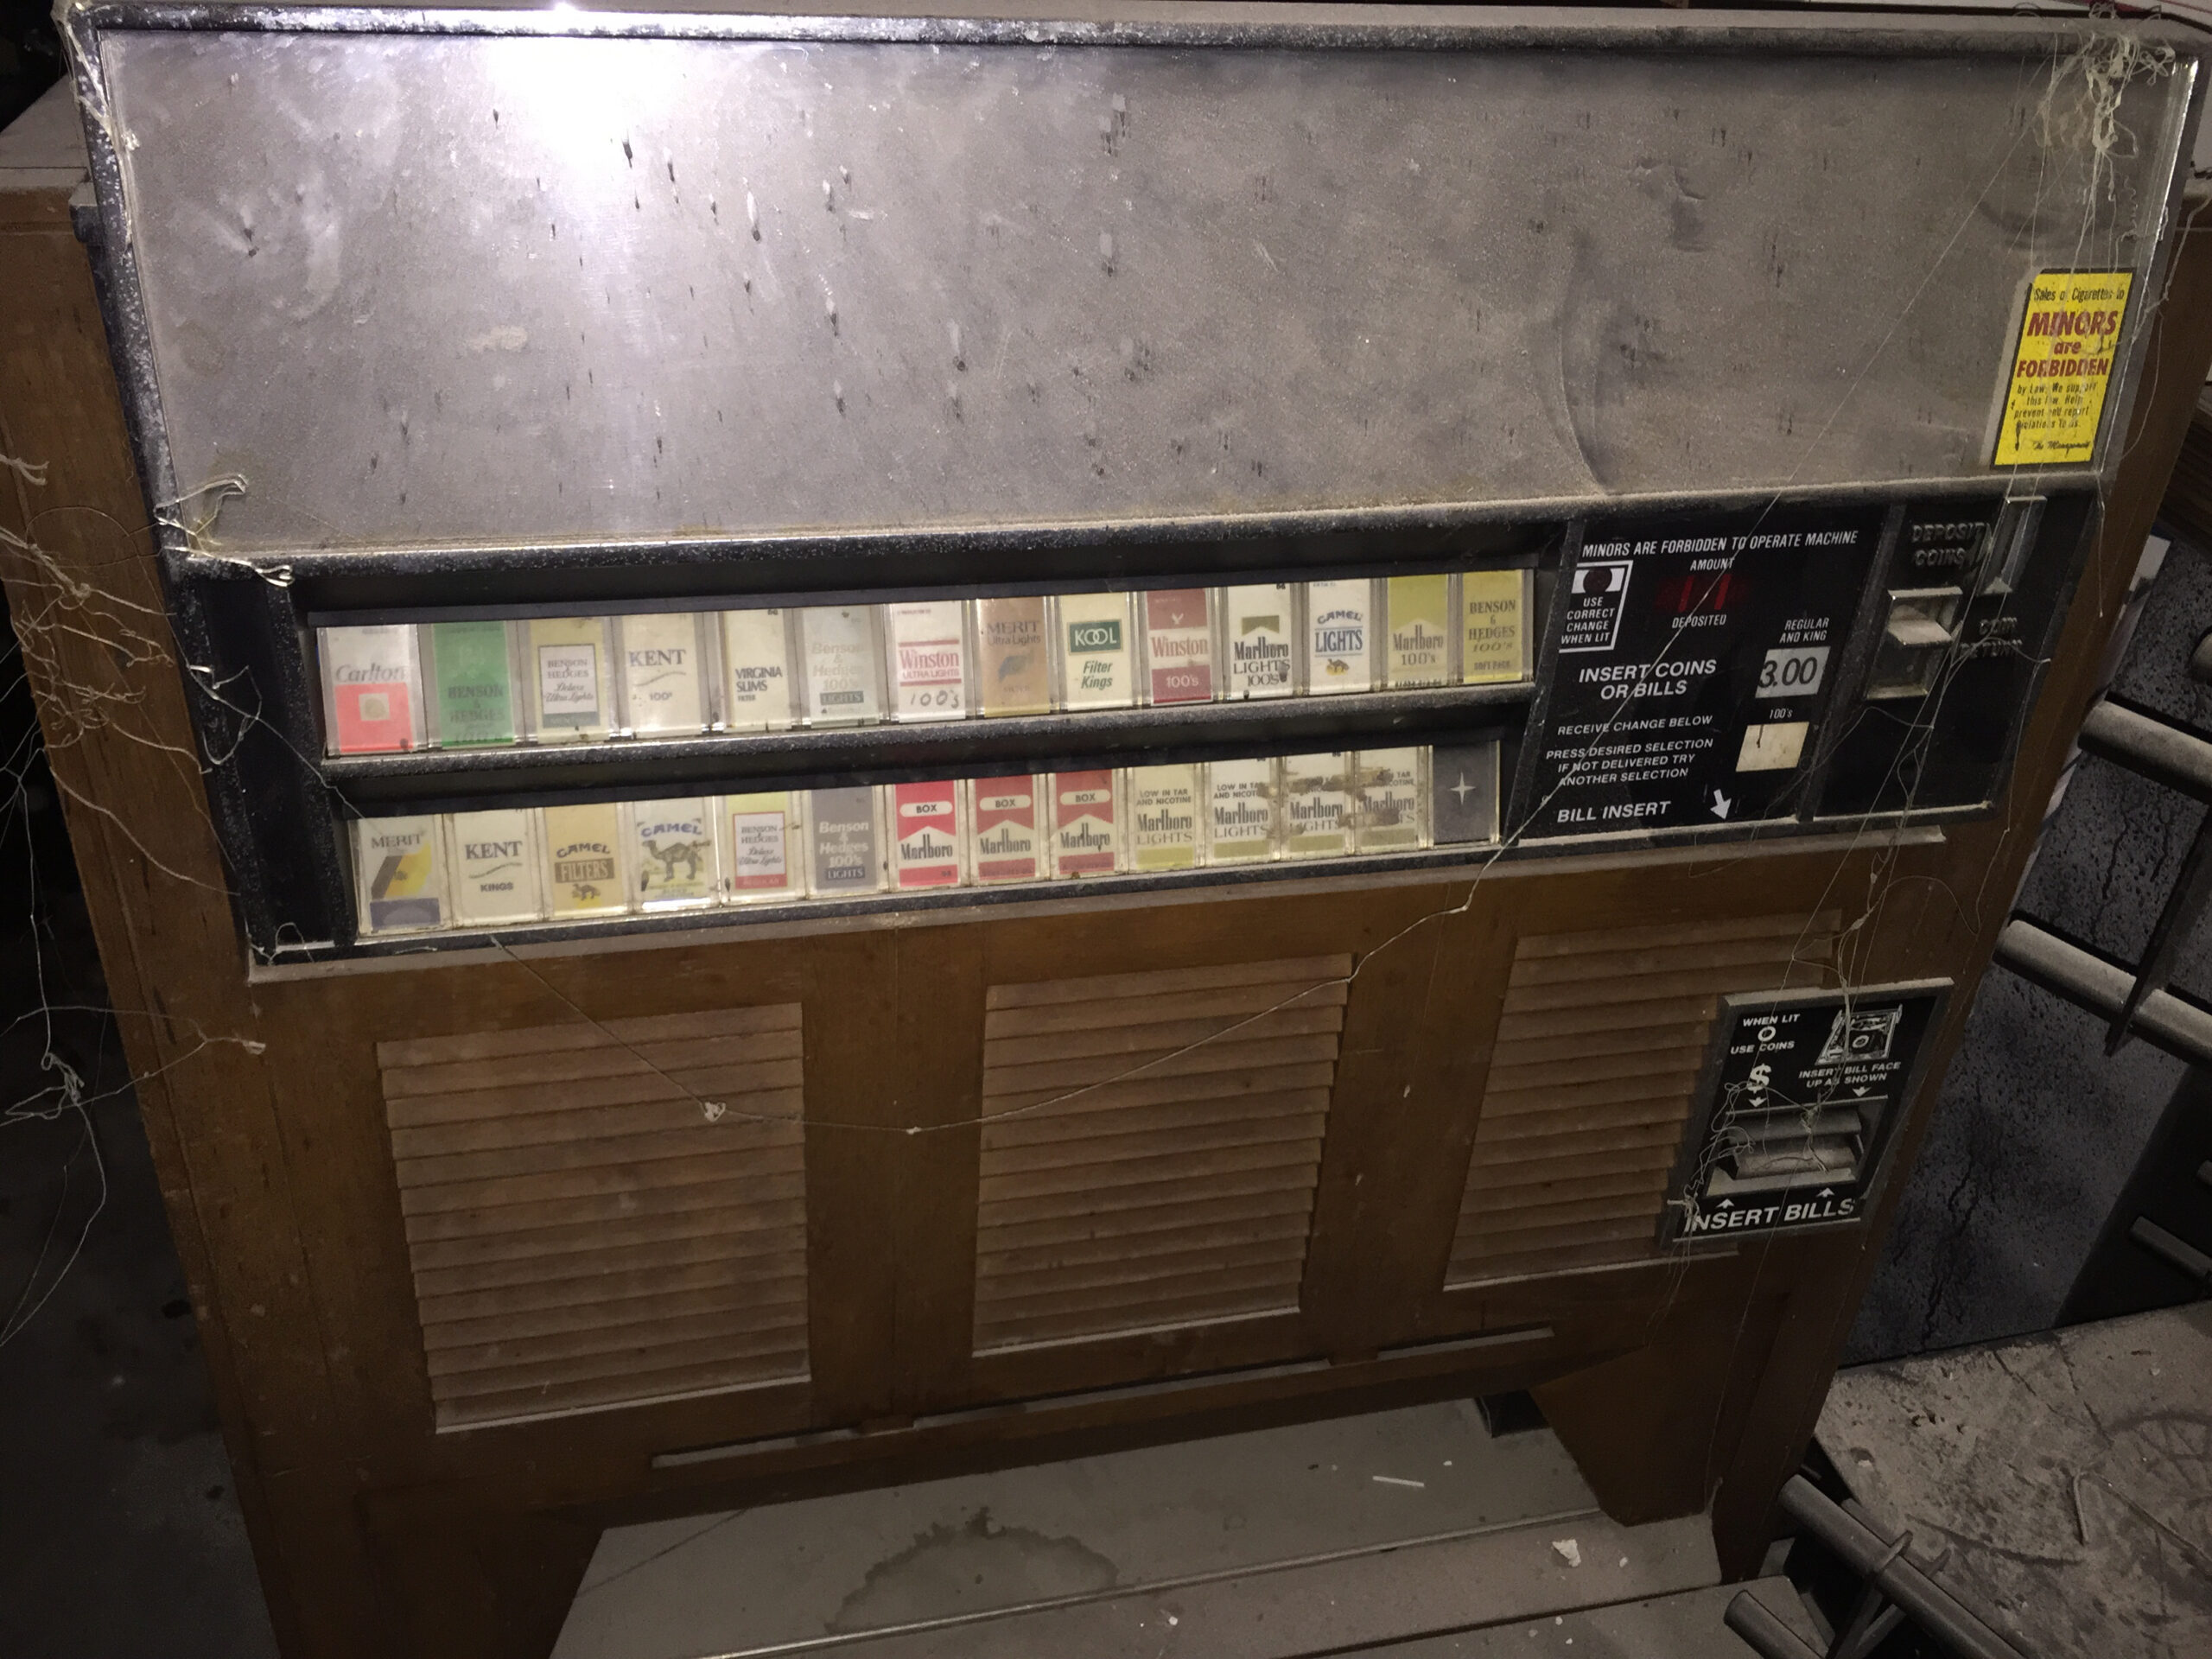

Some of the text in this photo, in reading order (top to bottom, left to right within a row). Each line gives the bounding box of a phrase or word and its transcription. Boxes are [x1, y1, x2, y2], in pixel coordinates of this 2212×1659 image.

[2034, 288, 2056, 302] Sales
[2027, 311, 2118, 336] MINORS
[2054, 341, 2082, 354] are
[2017, 359, 2109, 378] FORBIDDEN
[2018, 384, 2027, 395] by
[2066, 382, 2097, 392] suport
[2027, 396, 2041, 406] this
[2045, 396, 2058, 405] lw
[2014, 408, 2044, 420] prevent
[2049, 406, 2062, 416] nd
[2017, 420, 2056, 429] iolatios
[1582, 531, 1859, 558] MINORS ARE FORBIDDEN TO OPERATE MACHINE
[1690, 557, 1734, 571] AMOUNT
[1470, 599, 1516, 614] BENSON
[1583, 596, 1603, 607] USE
[1317, 609, 1363, 625] CAMEL
[1567, 608, 1615, 620] CORRECT
[987, 620, 1039, 634] MERIT
[1567, 620, 1609, 632] CHANGE
[1672, 614, 1727, 629] DEPOSITED
[1785, 618, 1829, 631] REGULAR
[988, 632, 1041, 646] Ultra Lights
[1075, 627, 1117, 646] KOOL
[1315, 629, 1363, 652] LIGHTS
[1393, 625, 1444, 652] Marlboro
[1469, 626, 1516, 642] HEDGES
[1560, 632, 1610, 645] WHEN LIT
[1780, 630, 1827, 644] AND KING
[1151, 636, 1208, 658] Winston
[1234, 636, 1289, 661] Marlboro
[547, 659, 588, 669] BENSON
[629, 649, 686, 667] KENT
[899, 648, 959, 670] Winston
[1402, 652, 1437, 666] 100's
[335, 662, 406, 683] Carlton
[735, 666, 783, 679] VIRGINIA
[902, 669, 960, 679] ULTRA LIGHTS
[1084, 660, 1113, 674] Filter
[1233, 659, 1290, 675] LIGHTS
[1579, 659, 1718, 683] INSERT COINS
[1758, 657, 1818, 689] 3.00
[547, 670, 589, 679] HEDGES
[1166, 675, 1198, 688] 100's
[448, 683, 503, 698] BENSON
[736, 680, 767, 692] SLIMS
[1081, 677, 1113, 690] Kings
[1601, 680, 1687, 700] OR BILLS
[911, 690, 959, 709] 100's
[1770, 708, 1793, 720] 100's
[1558, 715, 1713, 735] RECEIVE CHANGE BELOW
[1546, 738, 1713, 760] PRESS DESIRED SELECTION
[1558, 753, 1695, 772] IF NOT DELIVERED TRY
[1558, 767, 1688, 787] ANOTHER SELECTION
[1239, 782, 1247, 791] IN
[1075, 793, 1096, 803] BOX
[1140, 790, 1159, 798] LOW
[1156, 796, 1192, 805] NICOTINE
[1213, 791, 1230, 800] AND
[916, 804, 937, 814] BOX
[995, 799, 1015, 809] BOX
[1290, 797, 1343, 819] Marlboro
[1363, 791, 1414, 813] Marlboro
[1214, 802, 1268, 826] Marlboro
[1558, 800, 1671, 823] BILL INSERT
[819, 822, 869, 833] Benson
[1137, 809, 1192, 833] Marlboro
[1290, 819, 1340, 832] LGHTS
[640, 822, 702, 837] CAMEL
[741, 825, 778, 834] BENSON
[1060, 823, 1110, 849] Marlboro
[1214, 825, 1268, 839] LIGHTS
[371, 834, 423, 849] MERIT
[741, 836, 779, 844] HEDGES
[980, 829, 1031, 855] Marlboro
[1136, 832, 1192, 845] LIGHTS
[465, 841, 523, 860] KENT
[556, 842, 611, 858] CAMEL
[820, 842, 869, 855] Hedges
[901, 834, 953, 860] Marlboro
[562, 861, 609, 880] FILTERS
[828, 868, 863, 879] LIGHTS
[480, 881, 514, 892] KINGS
[1742, 1014, 1801, 1027] WHEN LIT
[1730, 1040, 1795, 1055] USE COINS
[1844, 1065, 1868, 1075] BILL
[1872, 1061, 1901, 1071] FACE
[1806, 1080, 1823, 1089] UP
[1844, 1073, 1887, 1085] SHOWN
[1684, 1198, 1855, 1233] INSERT BILLS
